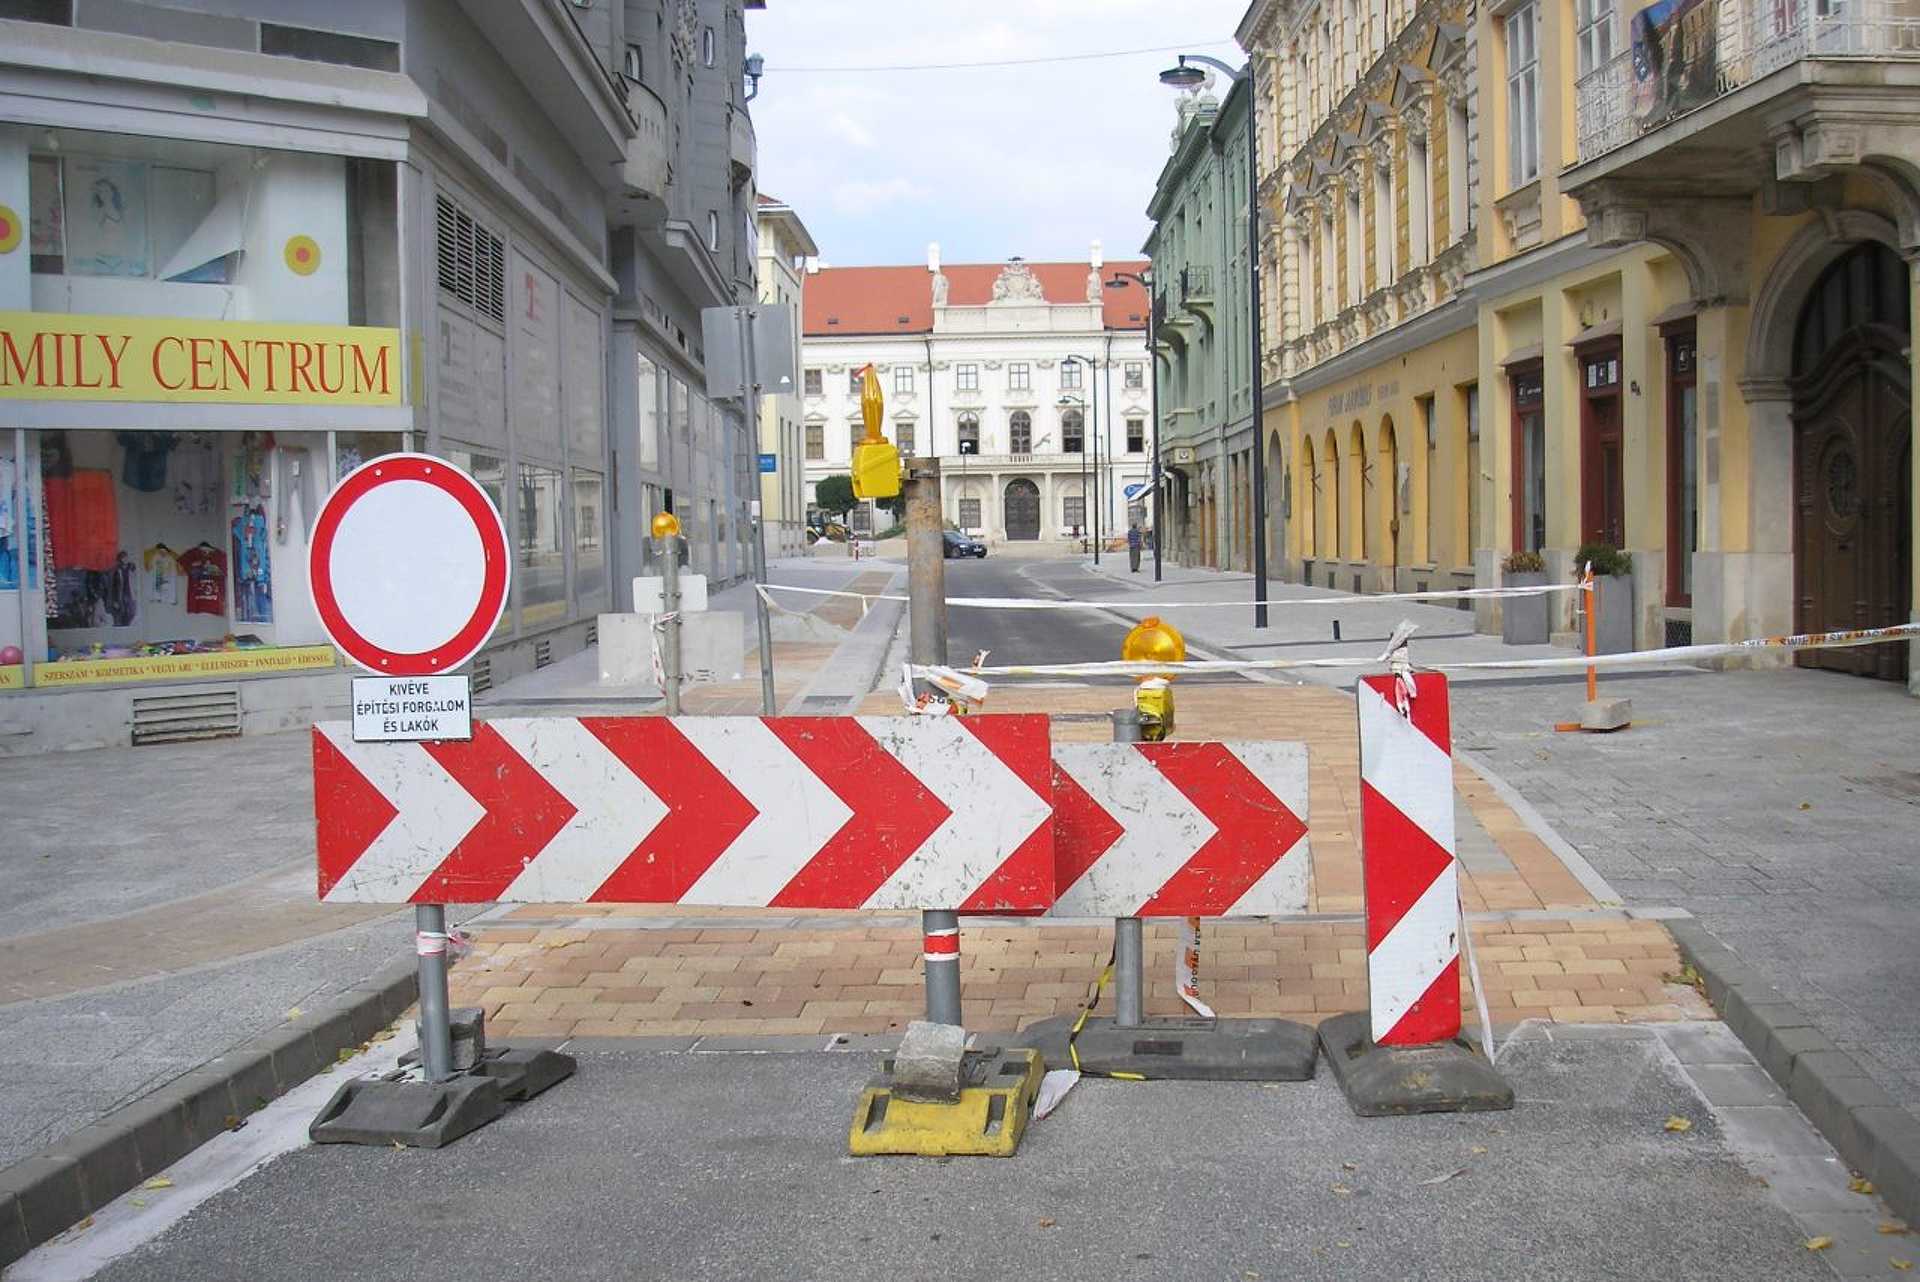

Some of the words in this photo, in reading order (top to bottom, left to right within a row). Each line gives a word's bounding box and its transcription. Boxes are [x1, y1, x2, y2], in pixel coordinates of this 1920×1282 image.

[152, 336, 392, 395] CENTRUM
[390, 680, 430, 696] KIVÉVE
[356, 699, 400, 715] ÉPÍTÉSI
[383, 717, 398, 733] ÉS
[401, 716, 439, 733] LAKÓK
